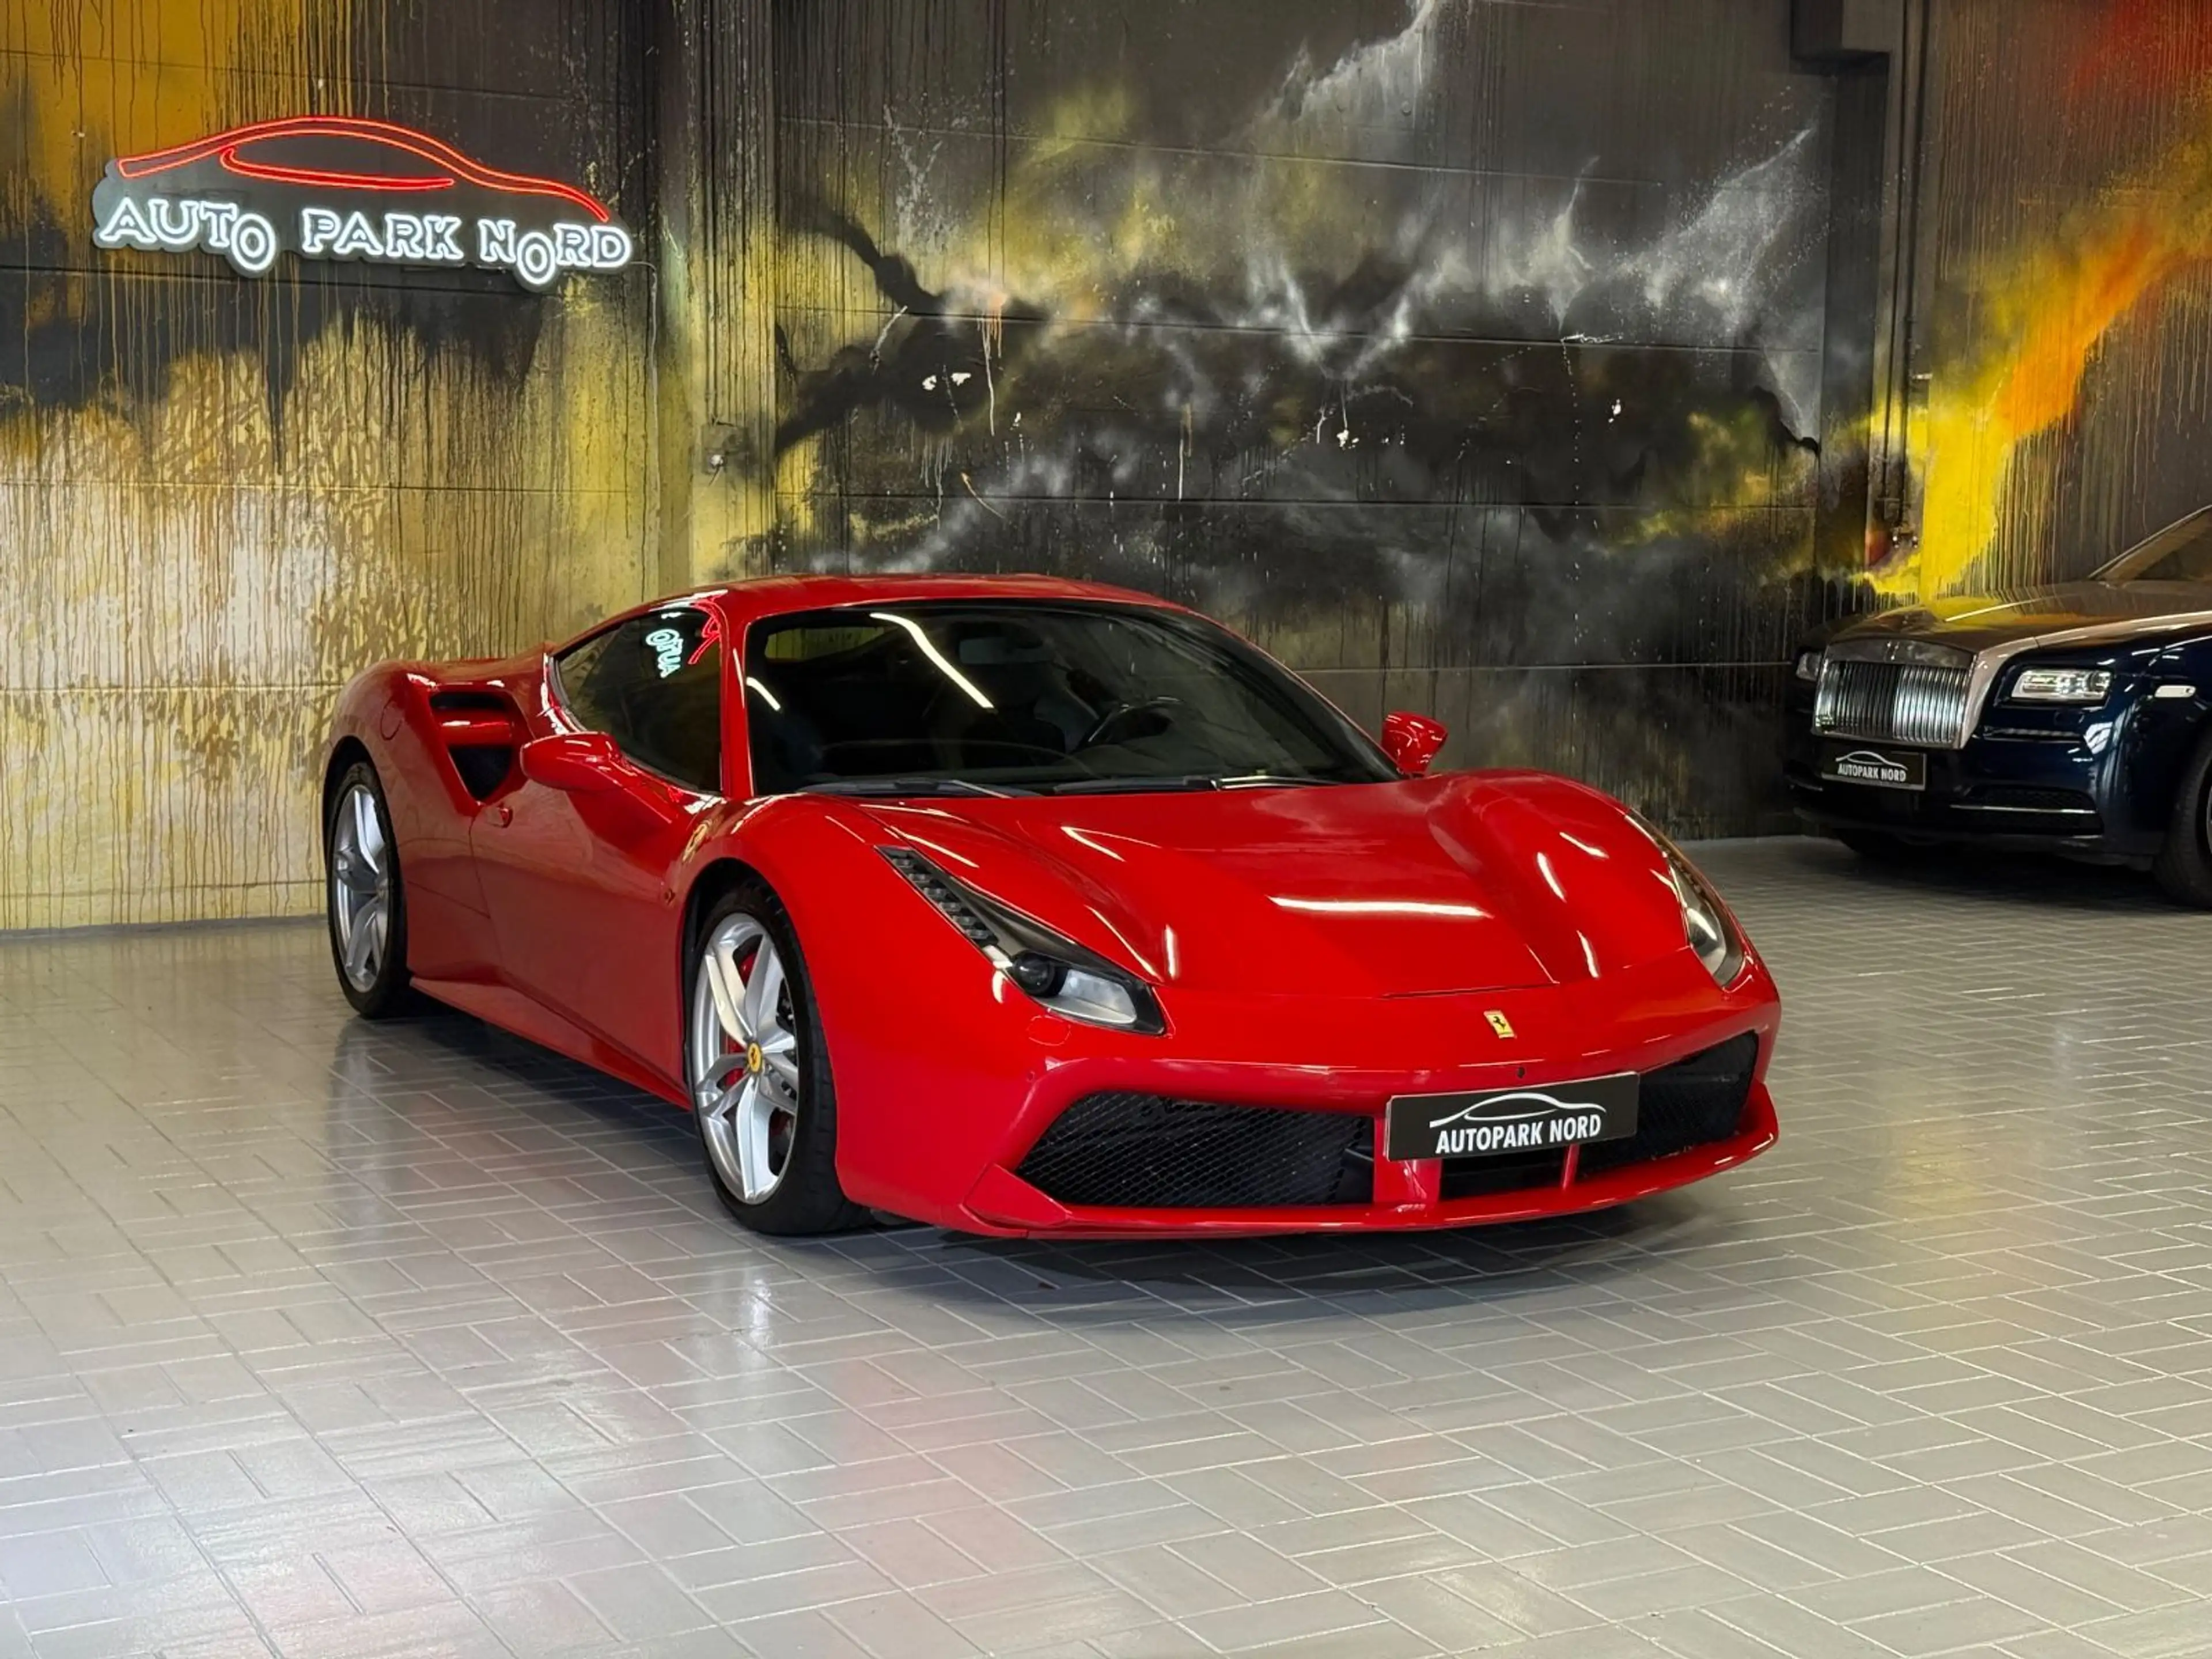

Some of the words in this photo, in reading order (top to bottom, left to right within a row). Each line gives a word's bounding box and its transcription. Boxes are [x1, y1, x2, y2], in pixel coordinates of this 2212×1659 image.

[100, 197, 277, 271] AUTO
[301, 207, 464, 260] PARK
[478, 219, 631, 286] NORD
[1837, 763, 1878, 779] AUTOPARK
[1881, 768, 1907, 782] NORD
[1435, 1121, 1544, 1154] AUTOPARK
[1549, 1114, 1601, 1143] NORD
